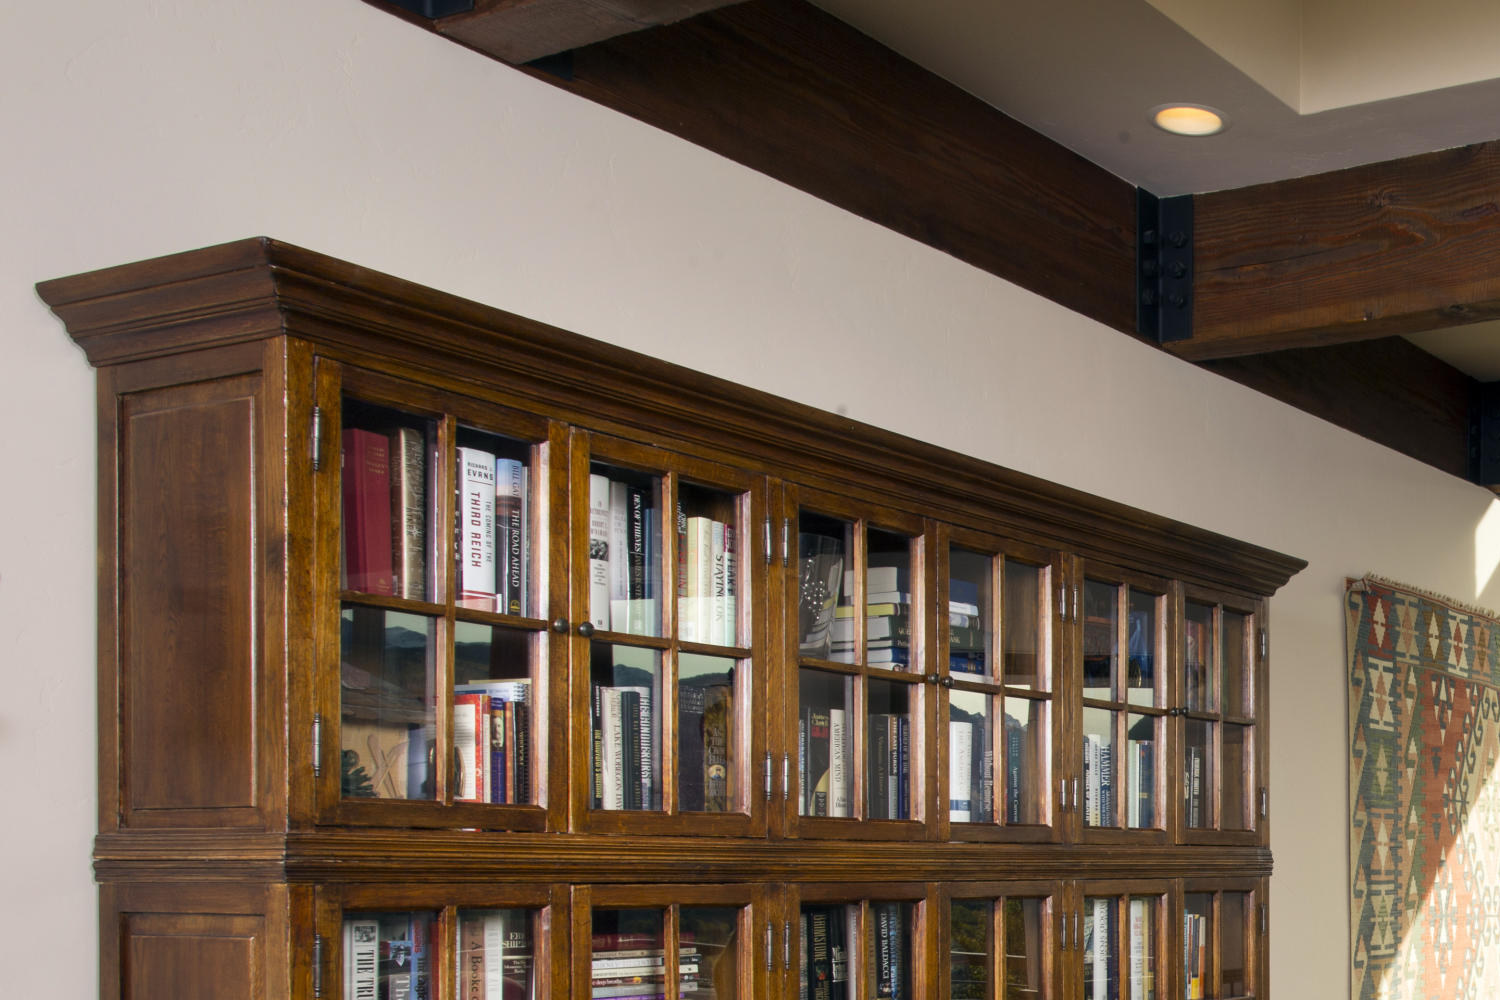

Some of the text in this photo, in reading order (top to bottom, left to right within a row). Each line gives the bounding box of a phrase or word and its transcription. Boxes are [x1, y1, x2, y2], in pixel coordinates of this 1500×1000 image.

[471, 492, 482, 568] THIRD REICH
[512, 509, 521, 587] THE ROAD AHEAD
[1100, 746, 1112, 786] HAMMER
[356, 950, 374, 974] THE
[471, 941, 482, 951] A
[880, 913, 890, 979] DAVID BALDACCI
[471, 956, 482, 992] Booke
